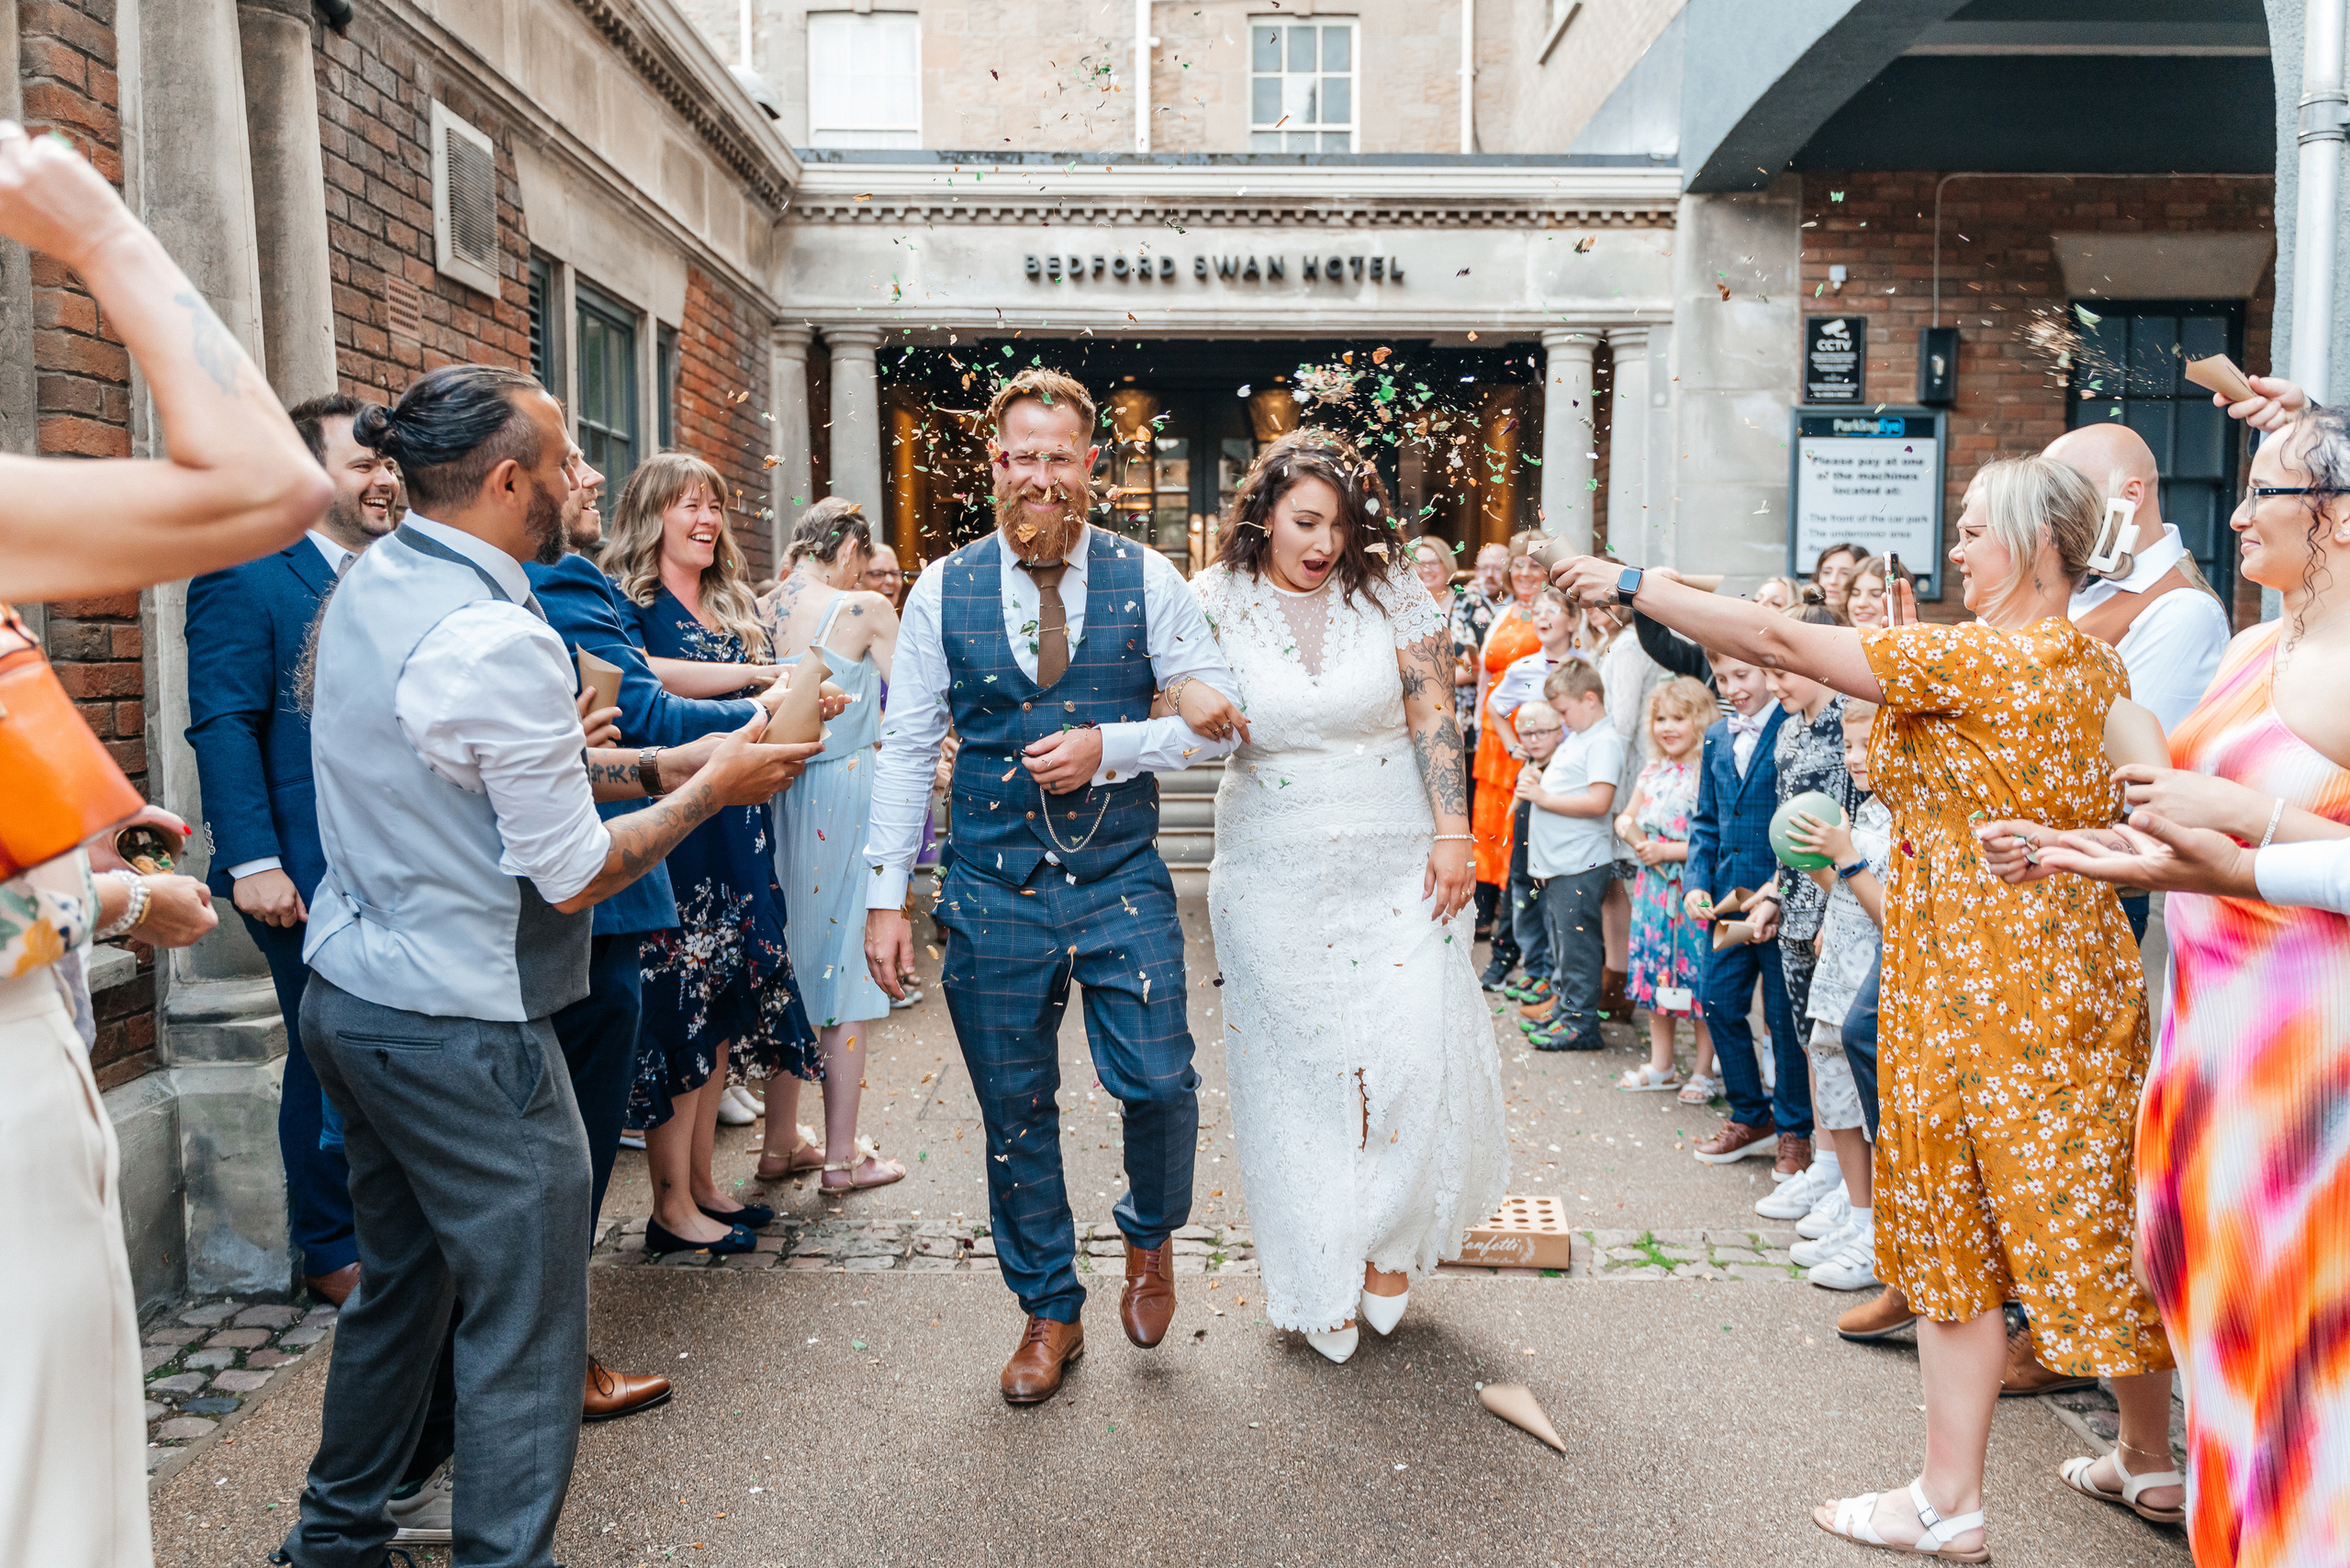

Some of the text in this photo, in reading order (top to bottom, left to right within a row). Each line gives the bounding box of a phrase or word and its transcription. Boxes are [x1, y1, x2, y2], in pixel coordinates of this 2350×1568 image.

[1024, 254, 1404, 279] BEDFORD SWAN HOTEL
[1817, 339, 1852, 352] CCTV
[1833, 419, 1901, 435] ParkingEye
[1812, 456, 1853, 465] Please
[1858, 458, 1879, 468] pay
[1885, 457, 1897, 465] at
[1817, 472, 1918, 480] of the machines
[1833, 487, 1881, 495] located
[1808, 514, 1827, 522] The
[1869, 514, 1885, 522] the
[1906, 515, 1929, 524] park
[1808, 530, 1827, 538] The
